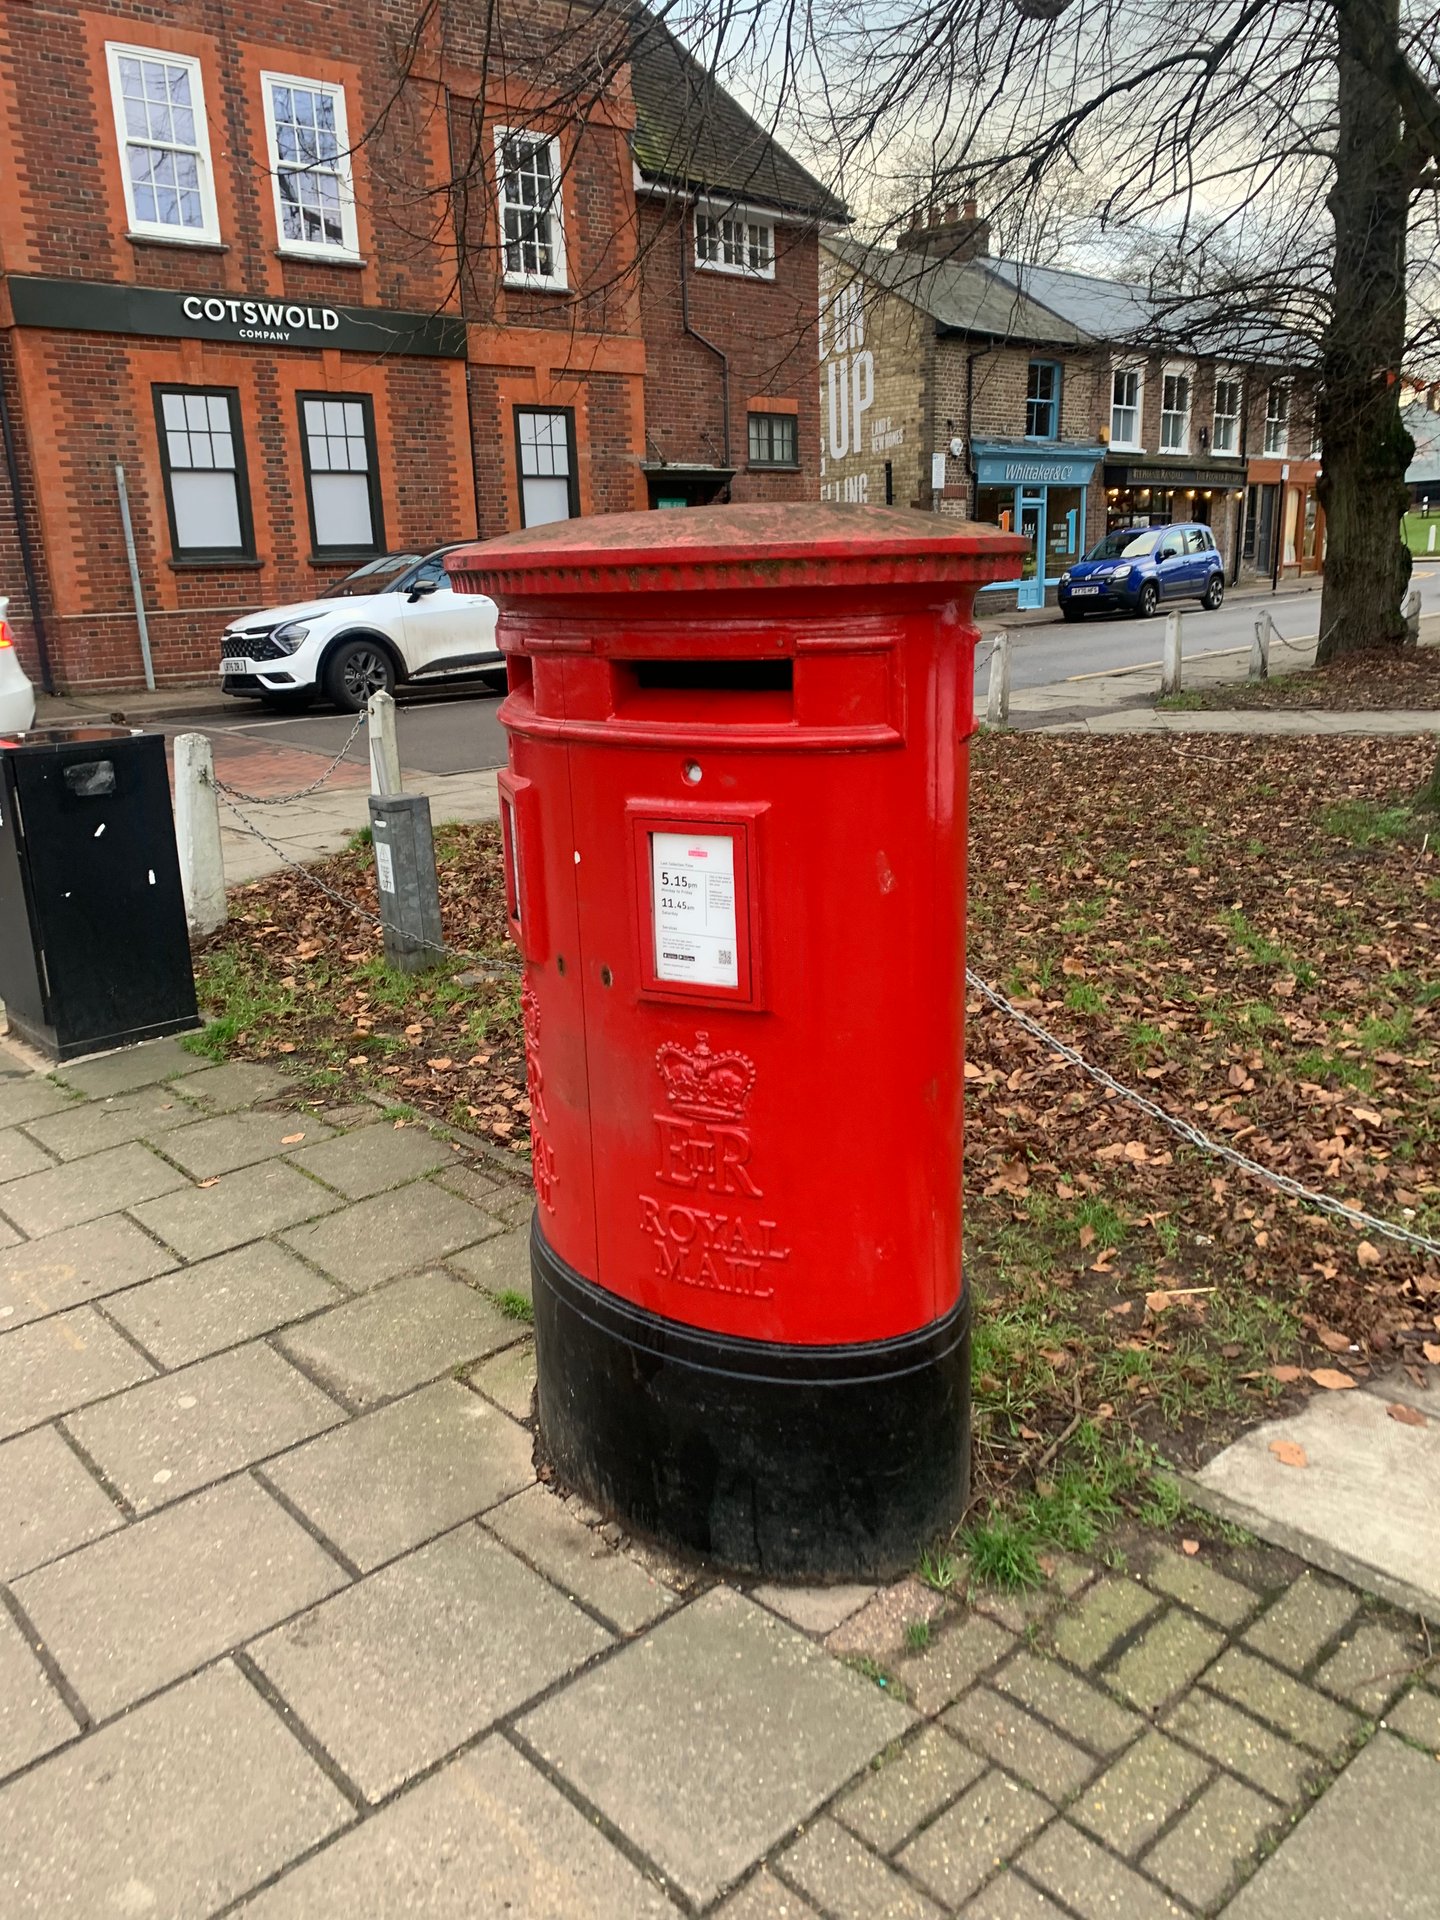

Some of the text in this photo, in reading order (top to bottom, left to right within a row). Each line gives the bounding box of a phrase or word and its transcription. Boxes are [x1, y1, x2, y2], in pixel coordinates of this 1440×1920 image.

[183, 296, 339, 331] COTSWOLD
[239, 329, 290, 341] COMPANY
[828, 350, 875, 460] UP
[638, 1194, 791, 1259] ROYAL
[653, 1239, 775, 1298] MAIL
